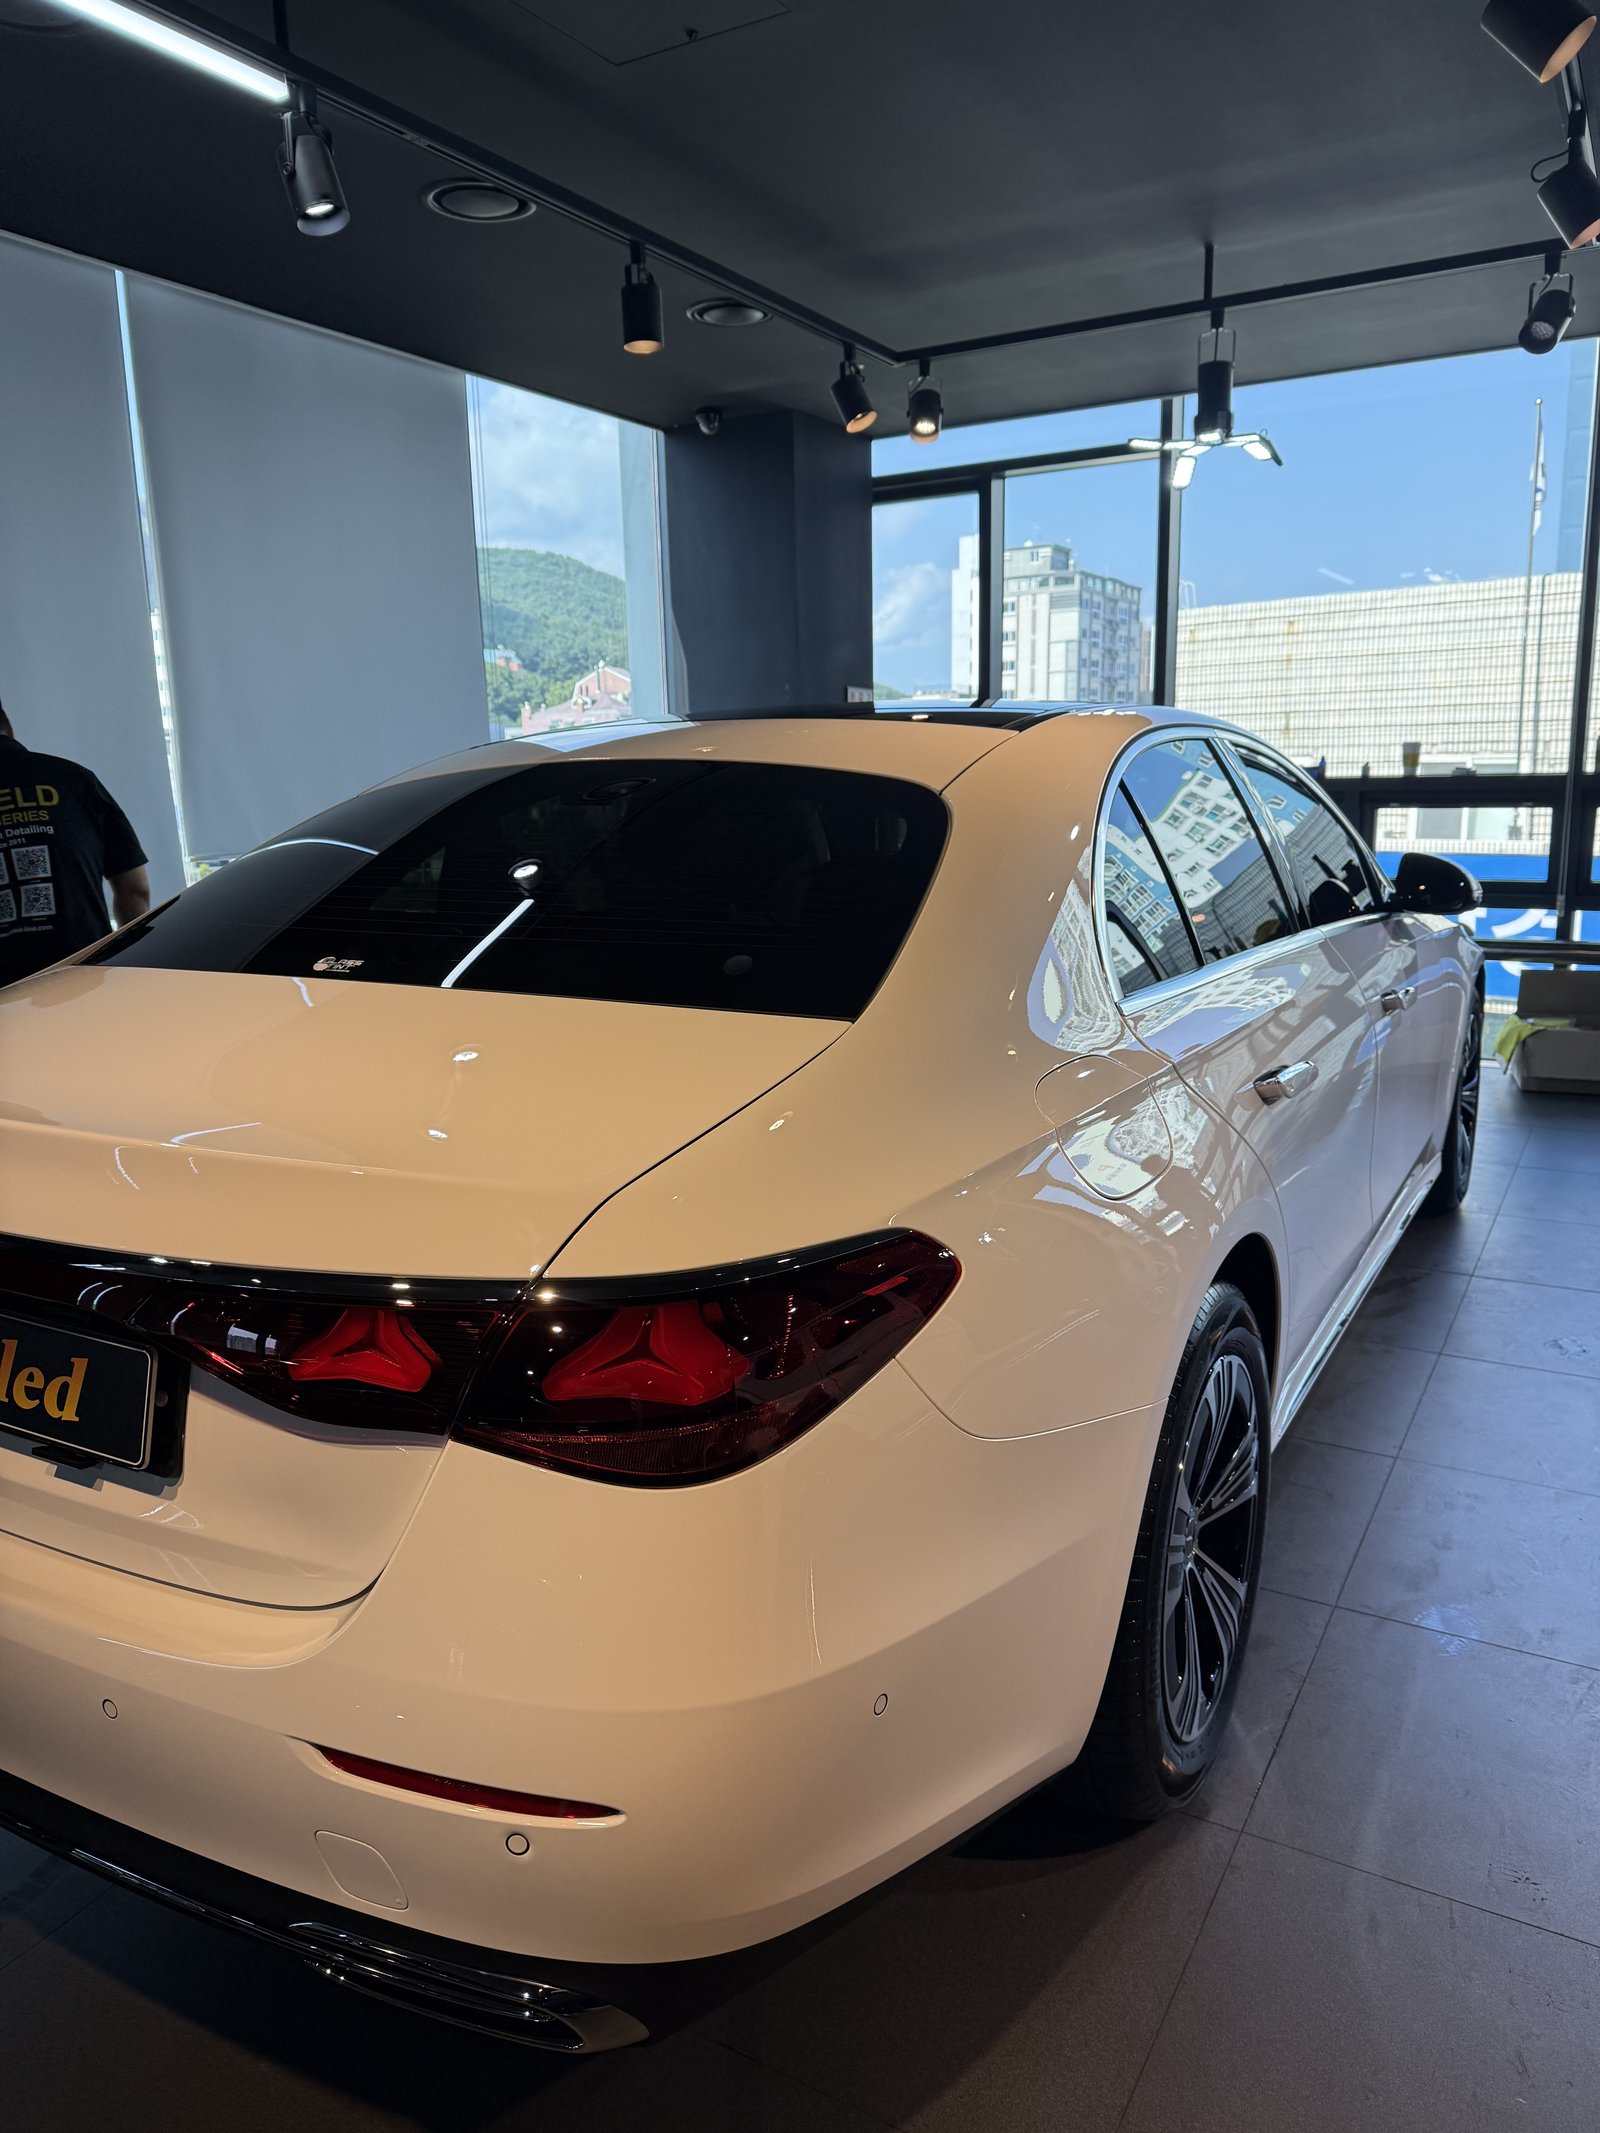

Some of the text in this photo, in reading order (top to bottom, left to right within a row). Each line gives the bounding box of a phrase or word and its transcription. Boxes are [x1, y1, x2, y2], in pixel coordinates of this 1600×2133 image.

[0, 809, 49, 827] ERIES
[5, 824, 54, 838] Detailing
[9, 837, 26, 847] 2011
[0, 1338, 89, 1422] led
